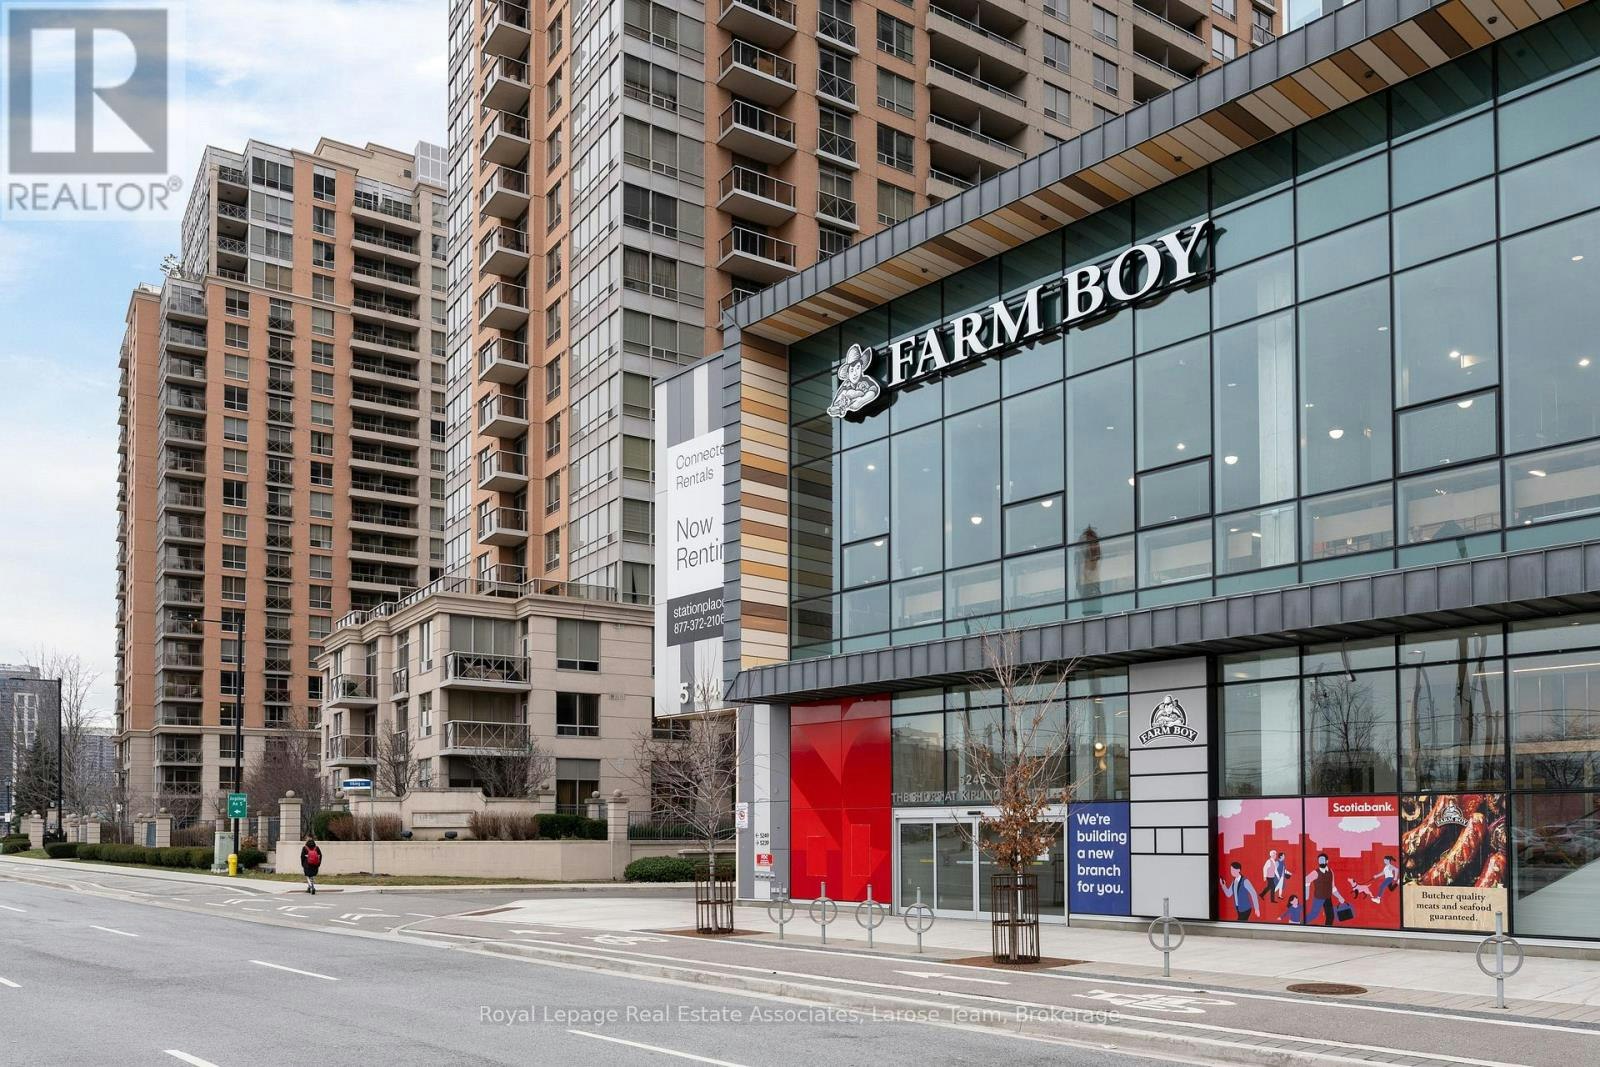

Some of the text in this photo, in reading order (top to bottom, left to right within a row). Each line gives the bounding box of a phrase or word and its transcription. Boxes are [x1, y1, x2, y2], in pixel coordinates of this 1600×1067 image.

[887, 219, 1211, 388] FARM BOY
[676, 467, 714, 490] Rentals
[676, 516, 714, 543] Now
[1140, 726, 1197, 743] FARM BOY
[1076, 830, 1127, 845] building
[1076, 849, 1114, 860] a new
[1077, 863, 1121, 877] branch
[1076, 880, 1124, 896] for you.
[1421, 891, 1486, 903] Butcher quality
[1441, 902, 1458, 910] and
[1459, 903, 1492, 912] seafood
[1429, 913, 1478, 922] guaranteed.
